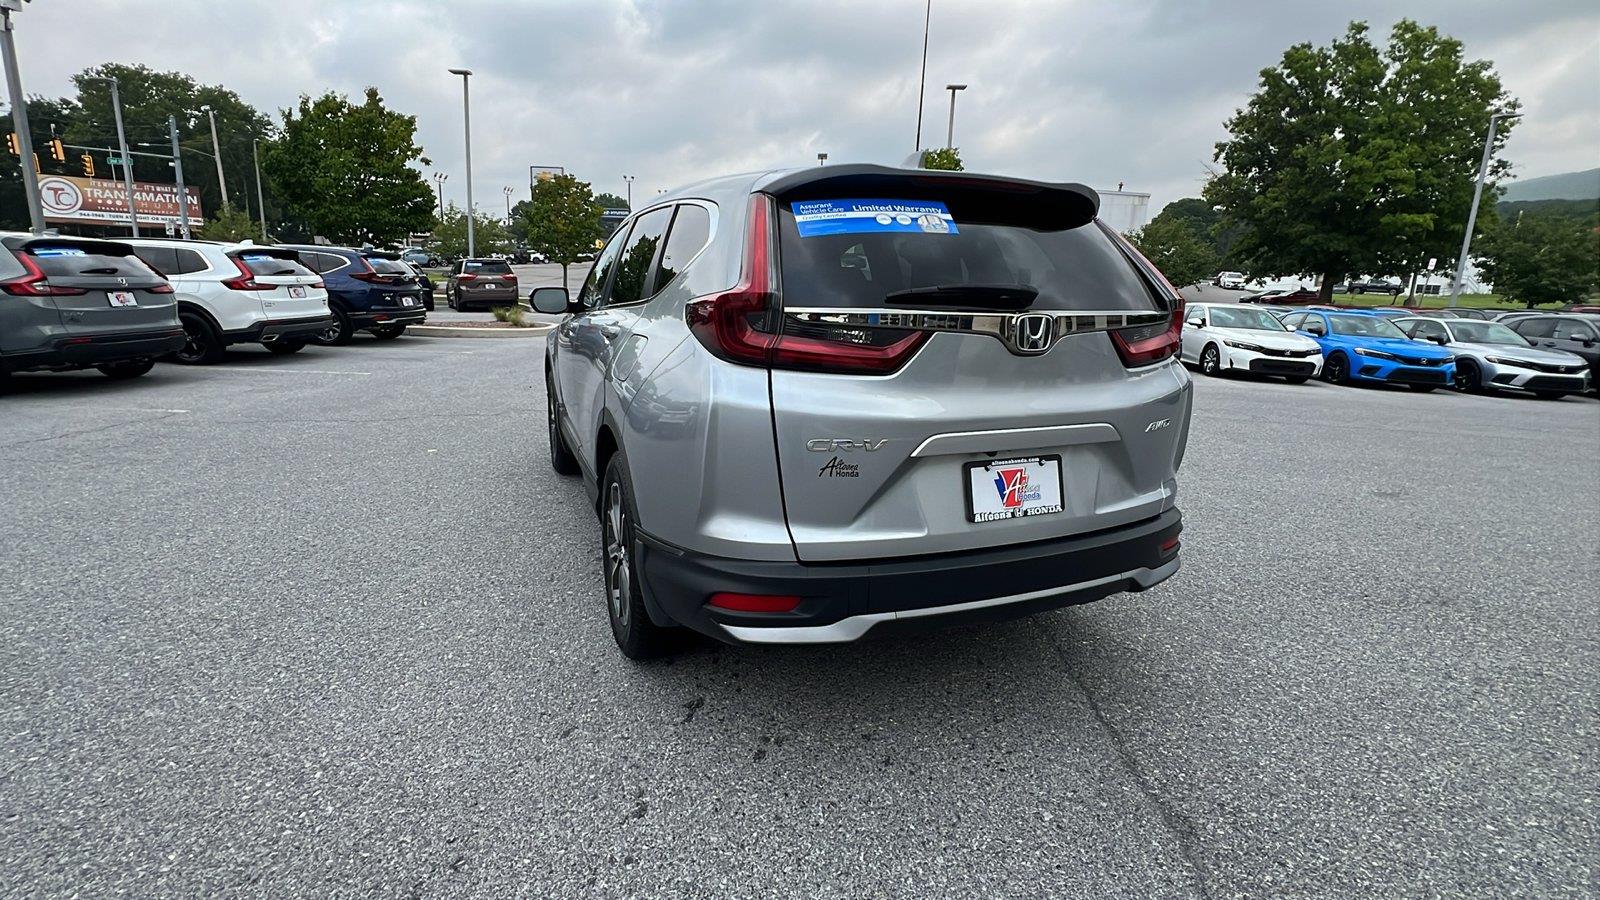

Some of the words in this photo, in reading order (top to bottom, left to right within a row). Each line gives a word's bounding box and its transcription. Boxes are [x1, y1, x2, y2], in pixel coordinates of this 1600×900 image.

[141, 202, 199, 210] HURH
[893, 205, 942, 214] Warranty
[806, 438, 889, 452] CR-V
[818, 456, 859, 478] Altoona
[974, 509, 1012, 523] Altoona
[1026, 505, 1063, 516] HONDA
